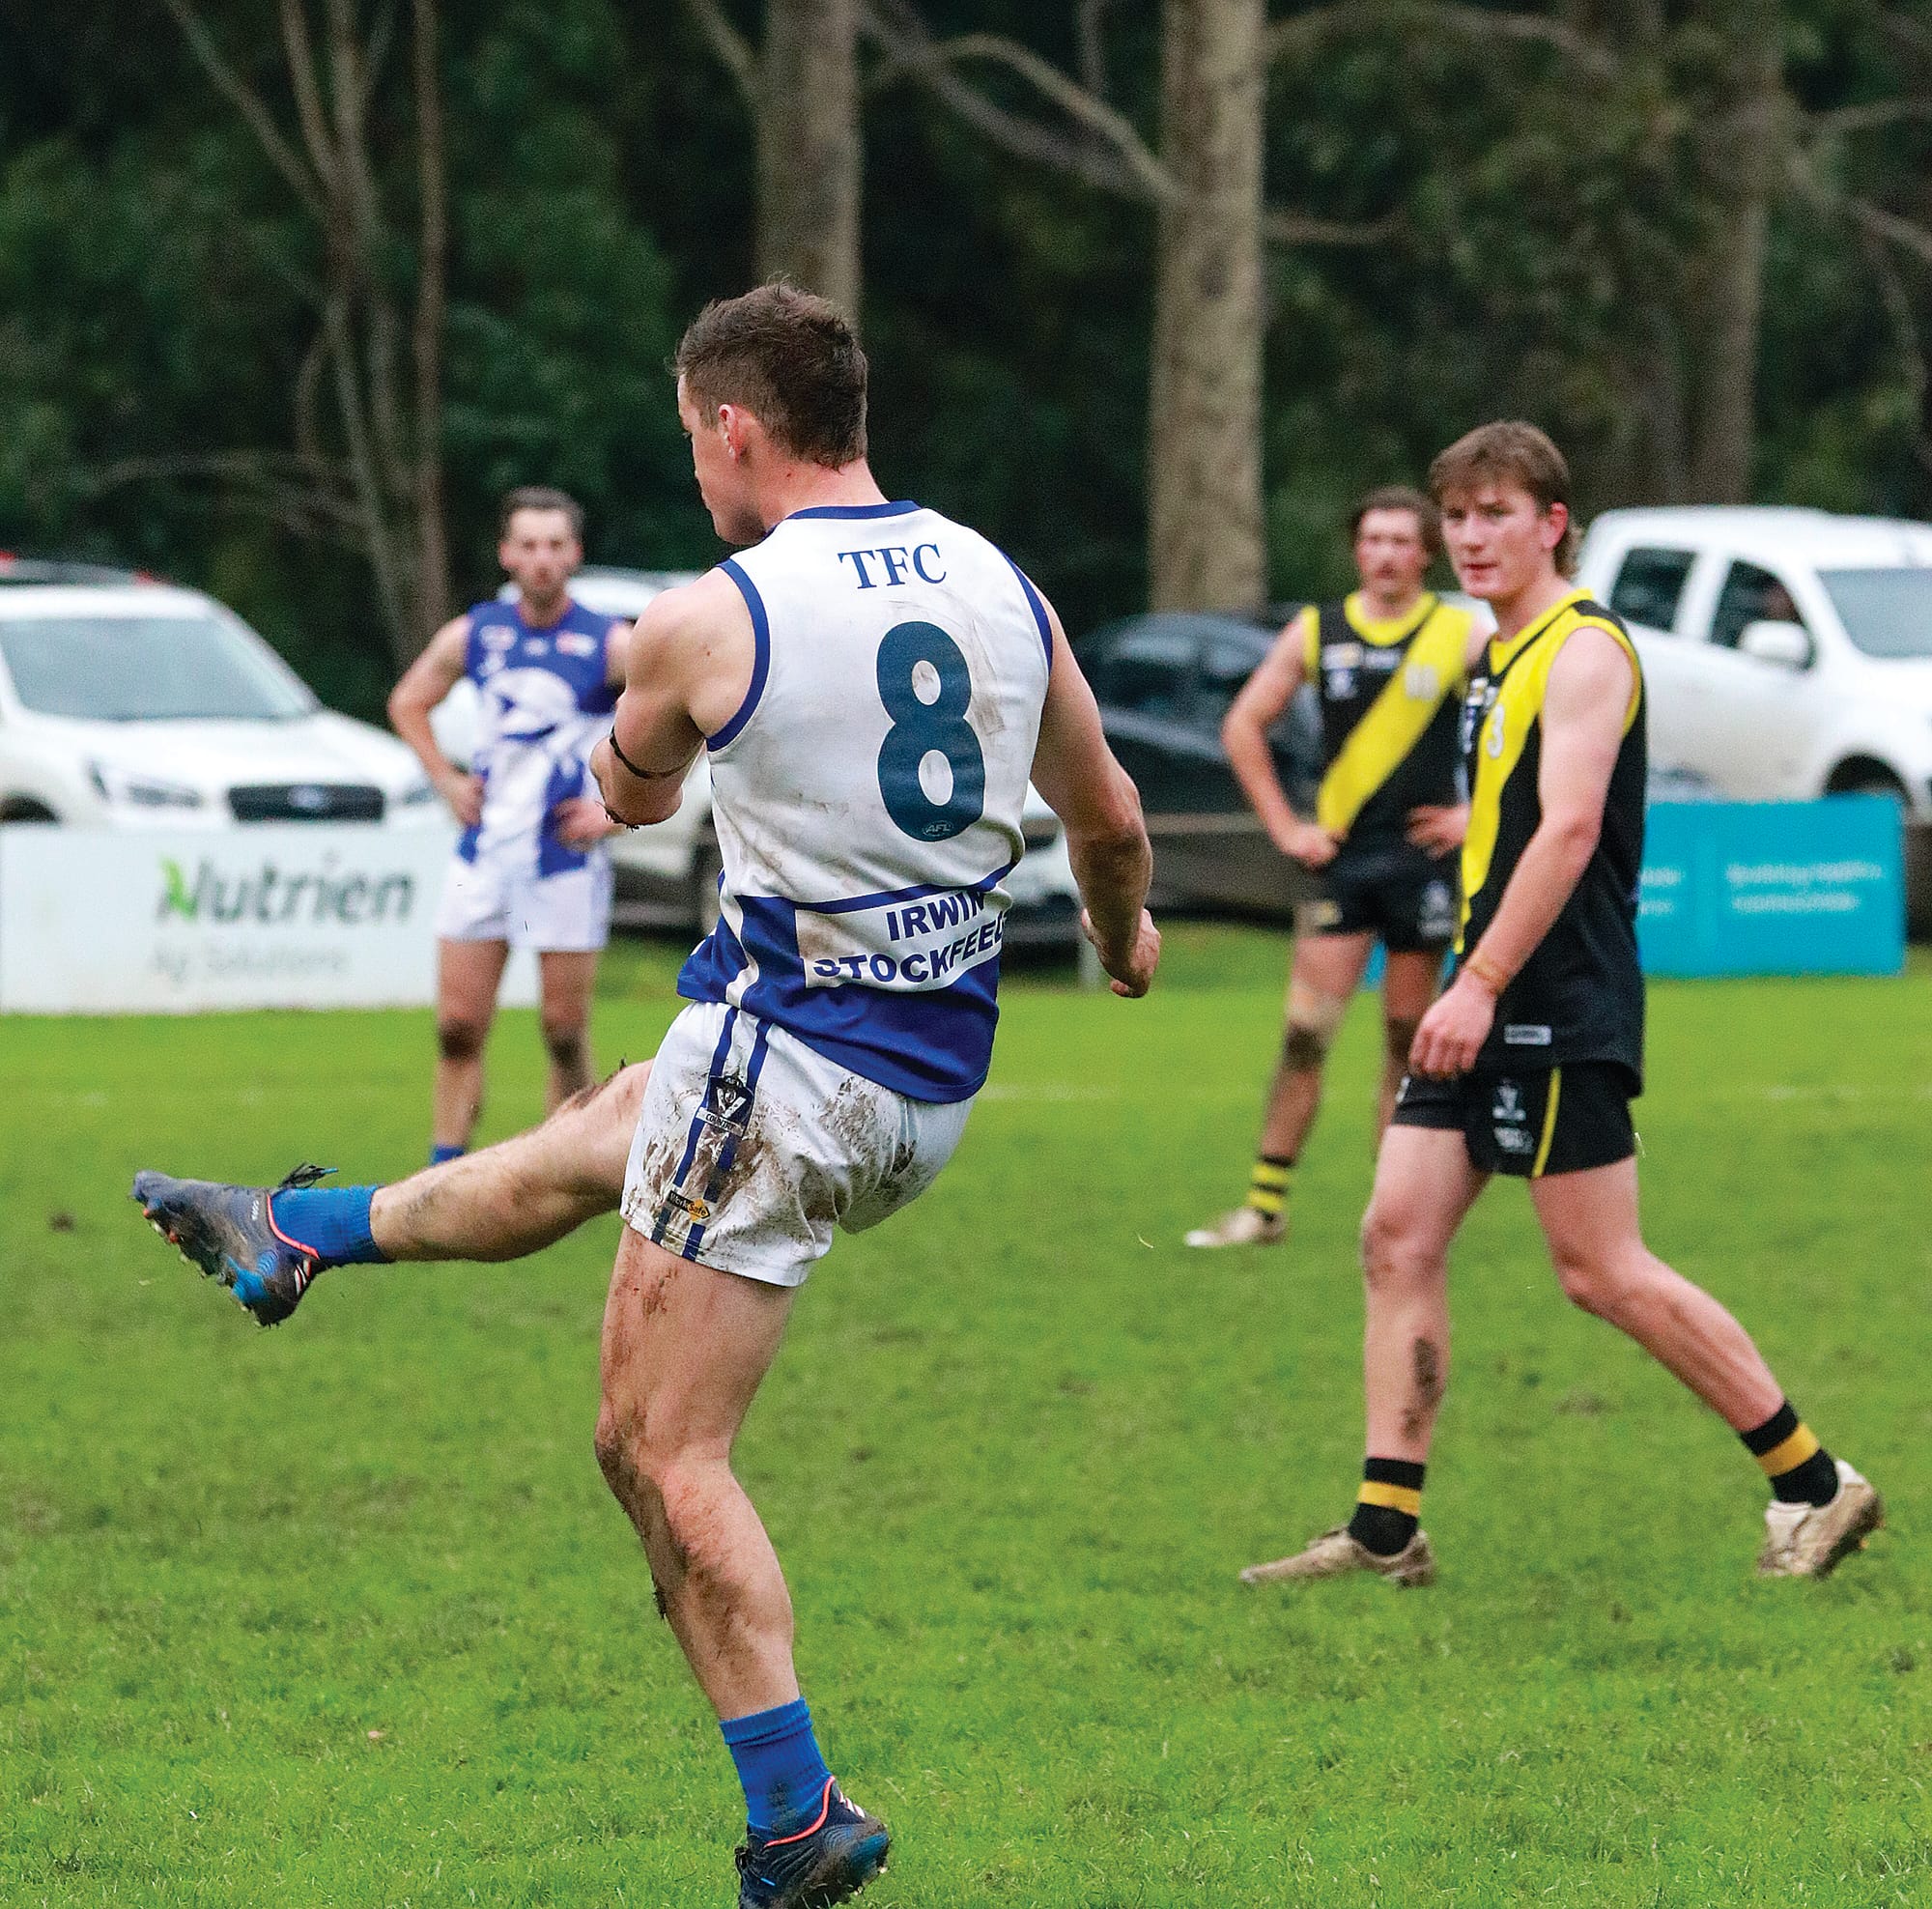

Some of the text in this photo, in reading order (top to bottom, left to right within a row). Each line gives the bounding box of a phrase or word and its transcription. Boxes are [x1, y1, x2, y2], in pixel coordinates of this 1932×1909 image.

[838, 544, 947, 589] TFC
[876, 621, 985, 842] 8
[156, 852, 412, 925] Nutrien
[886, 890, 984, 941] IRWIN
